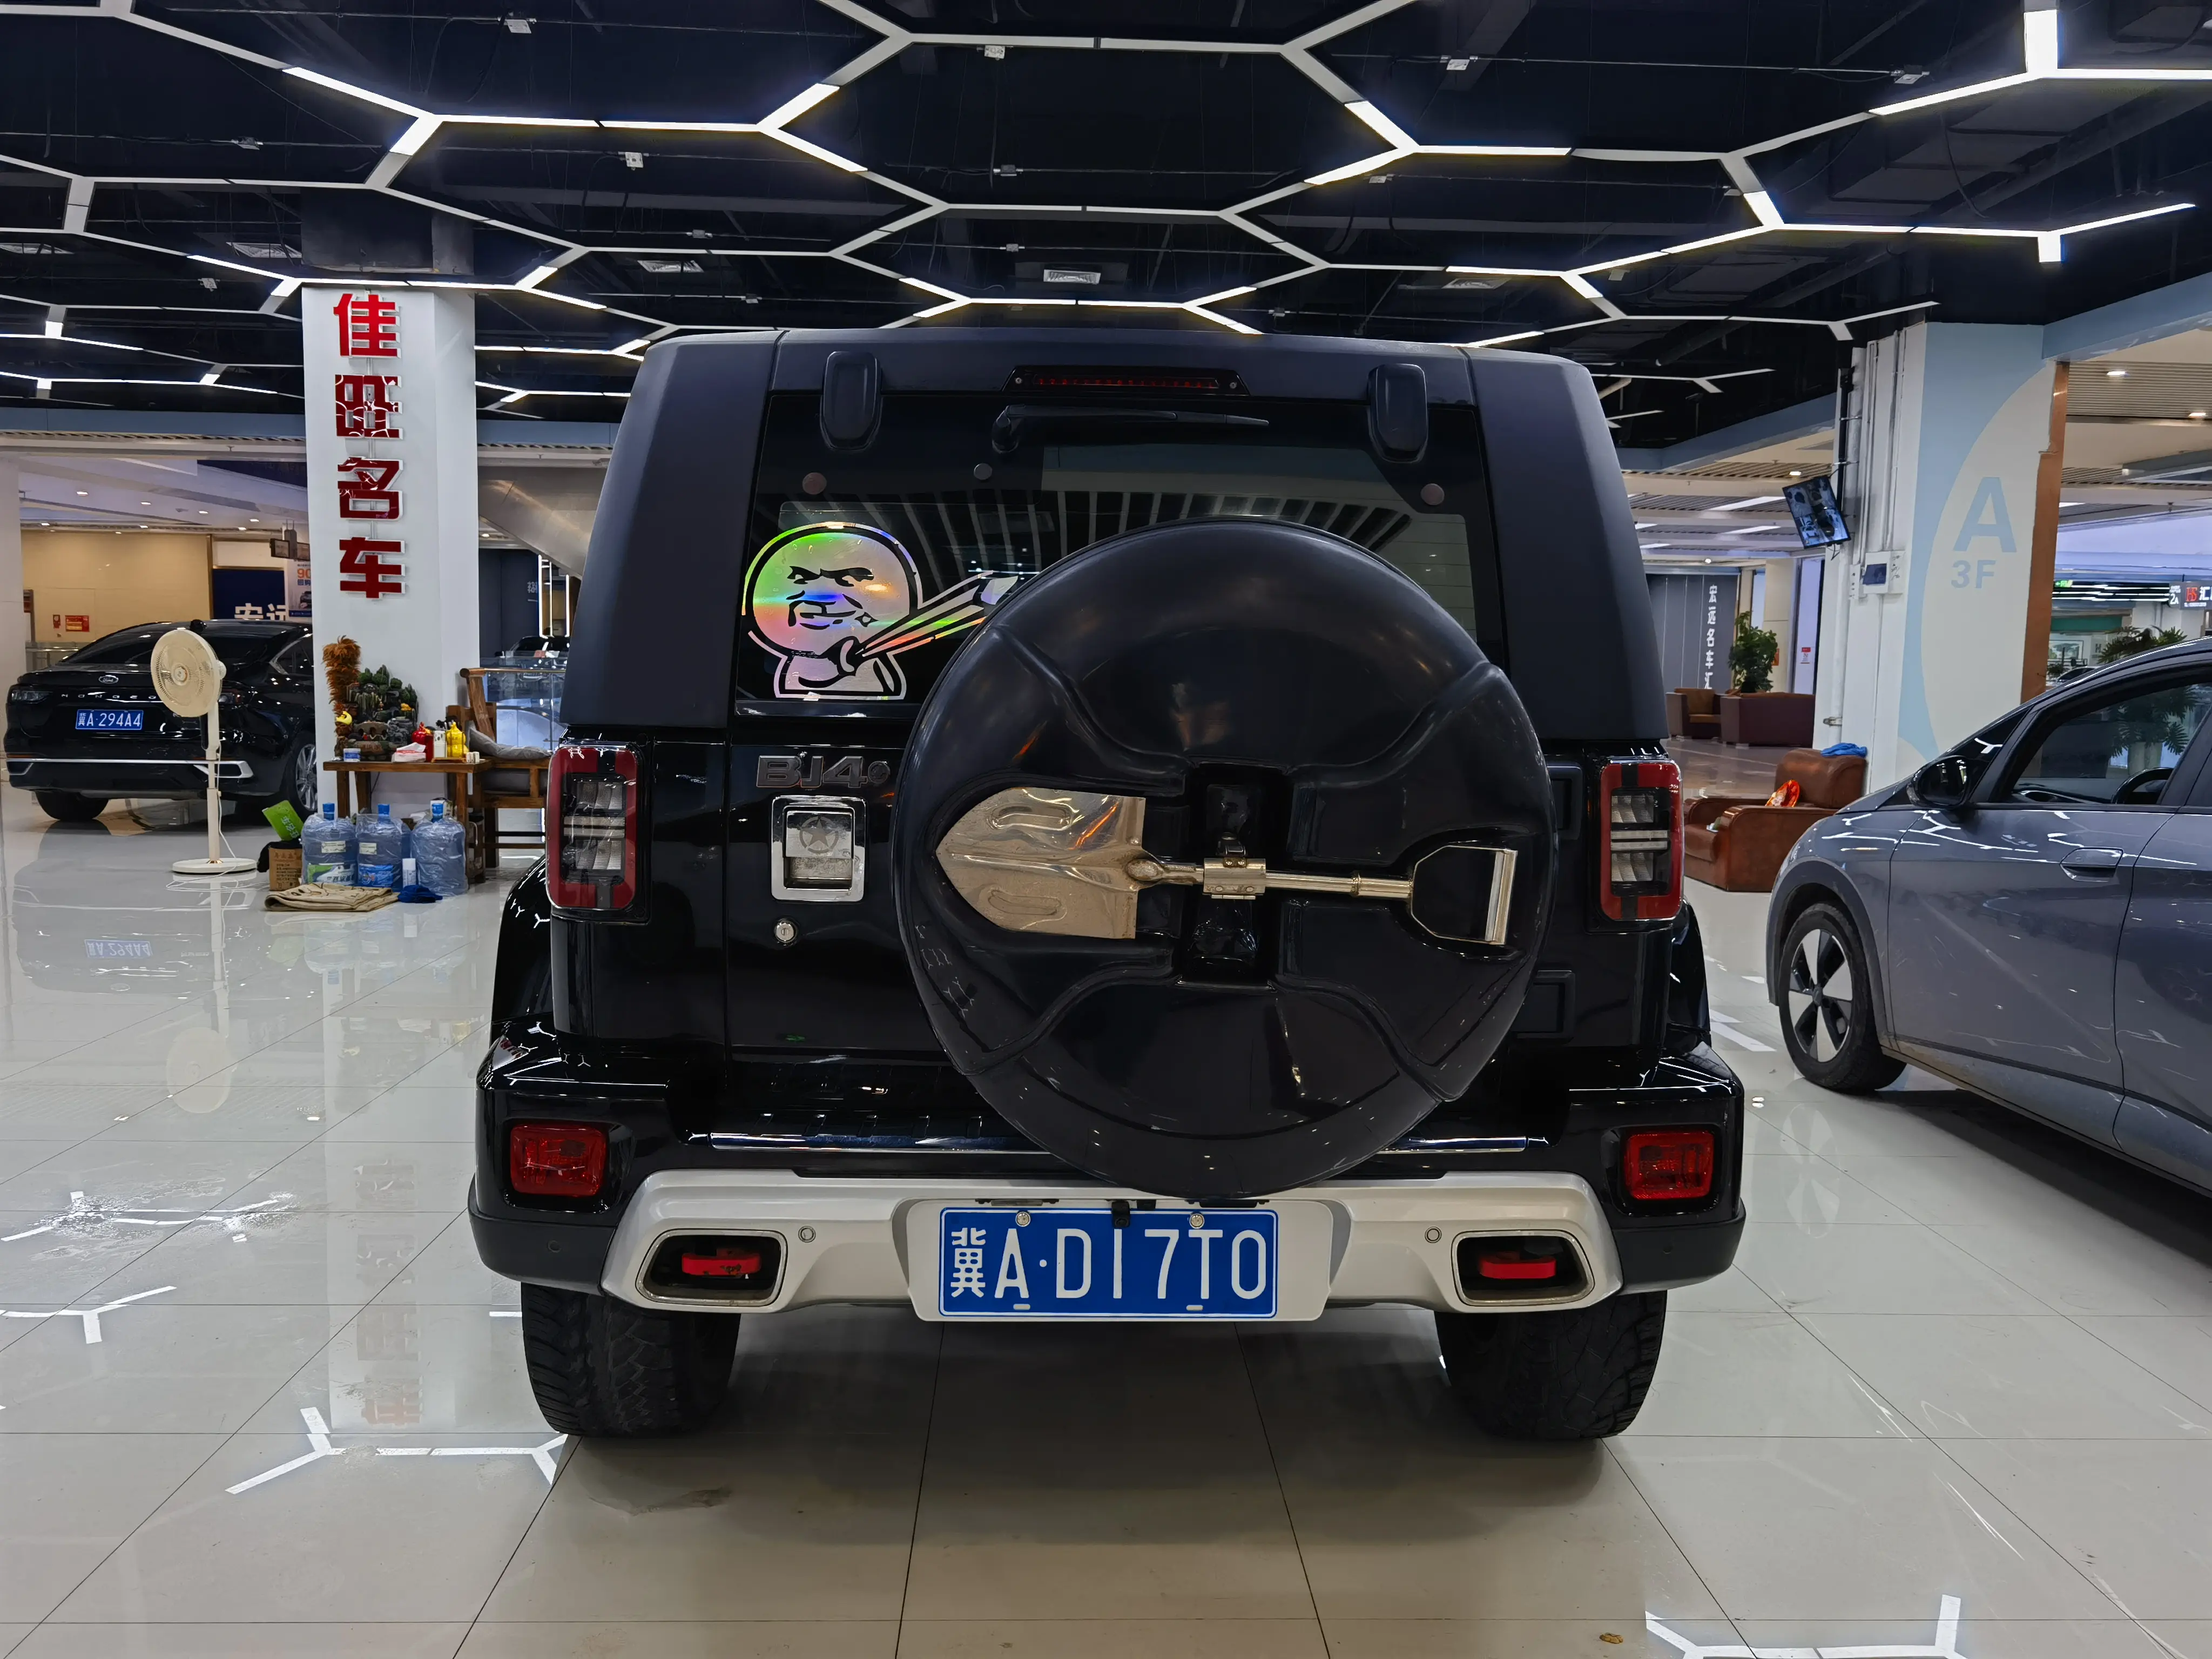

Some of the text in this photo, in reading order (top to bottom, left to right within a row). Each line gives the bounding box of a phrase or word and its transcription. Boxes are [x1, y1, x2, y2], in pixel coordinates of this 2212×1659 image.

[333, 293, 405, 599] 佳旺名车
[1953, 477, 2018, 553] A
[1951, 559, 1997, 589] 3F
[1704, 584, 1718, 689] 宏远名车汇
[78, 712, 141, 727] 冀A·294A4
[950, 1227, 1267, 1299] 冀A·D17T0
